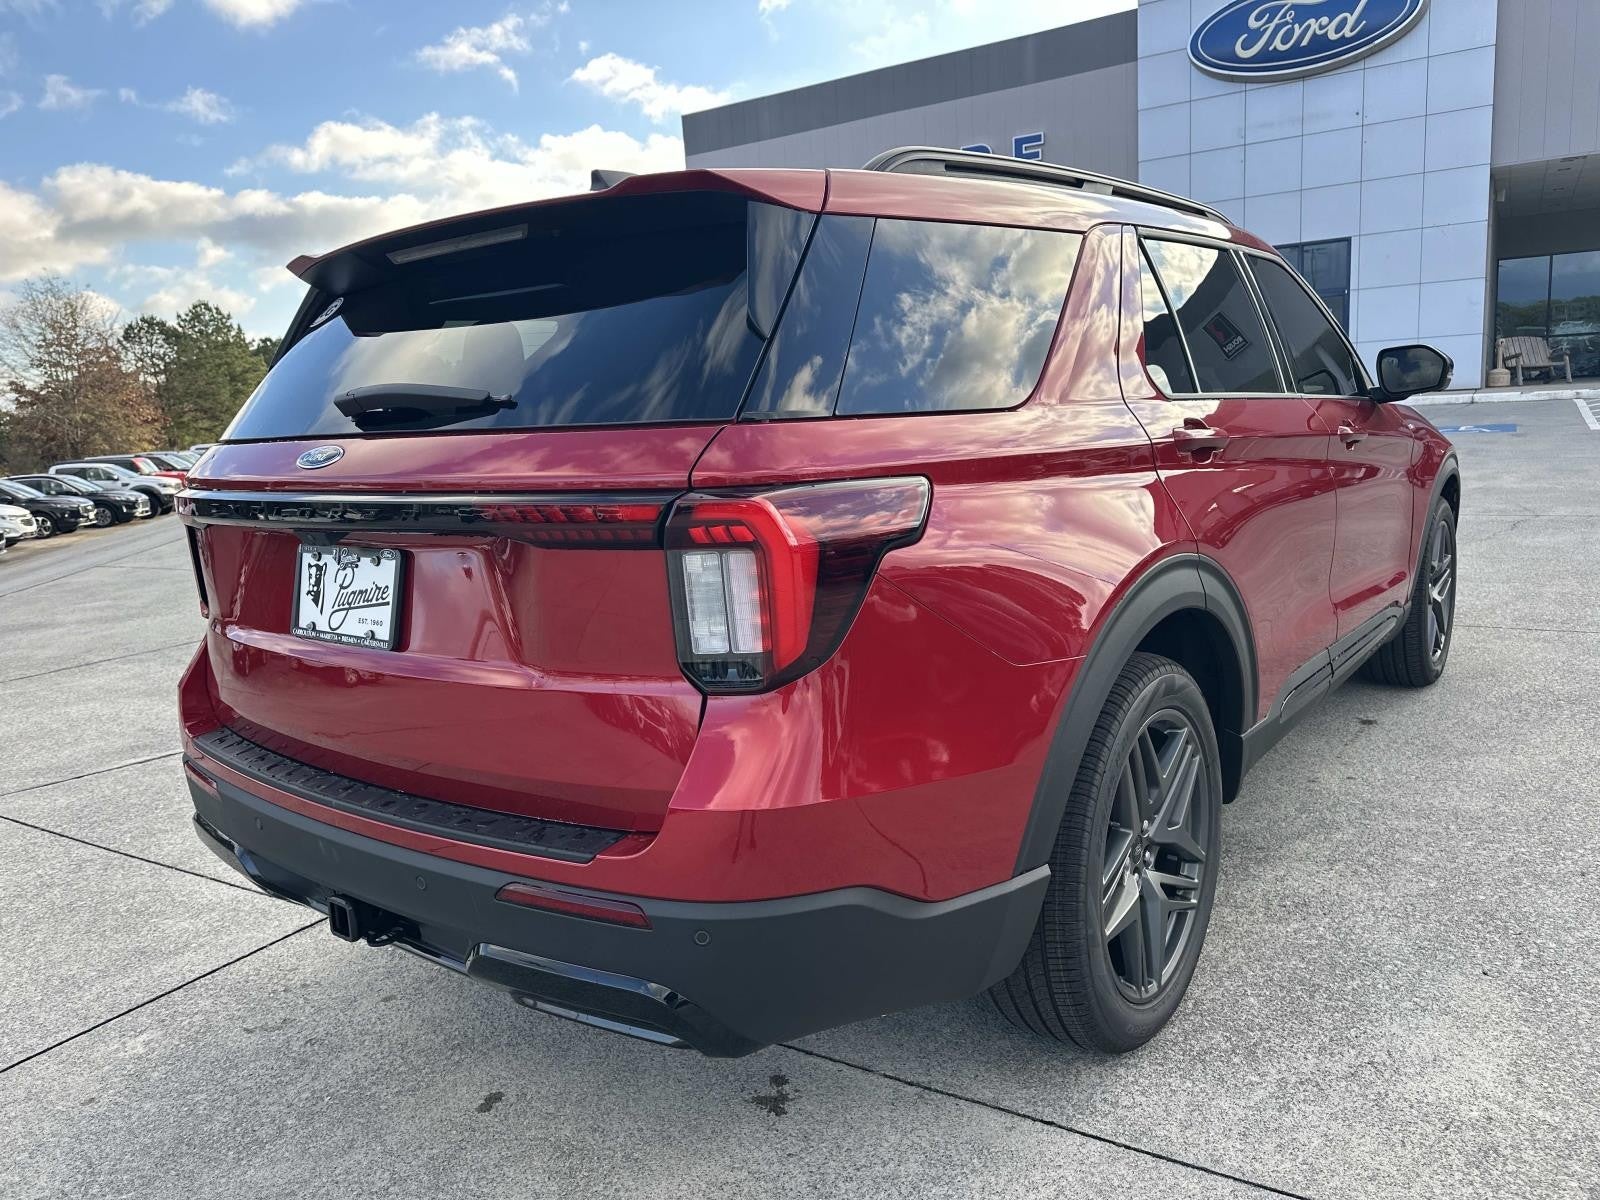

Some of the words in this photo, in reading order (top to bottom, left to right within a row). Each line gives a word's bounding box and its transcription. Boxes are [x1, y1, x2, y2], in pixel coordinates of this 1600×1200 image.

[1235, 0, 1367, 58] Ford
[328, 567, 390, 631] Pugmire
[358, 617, 369, 625] EST.
[370, 618, 384, 627] 1960
